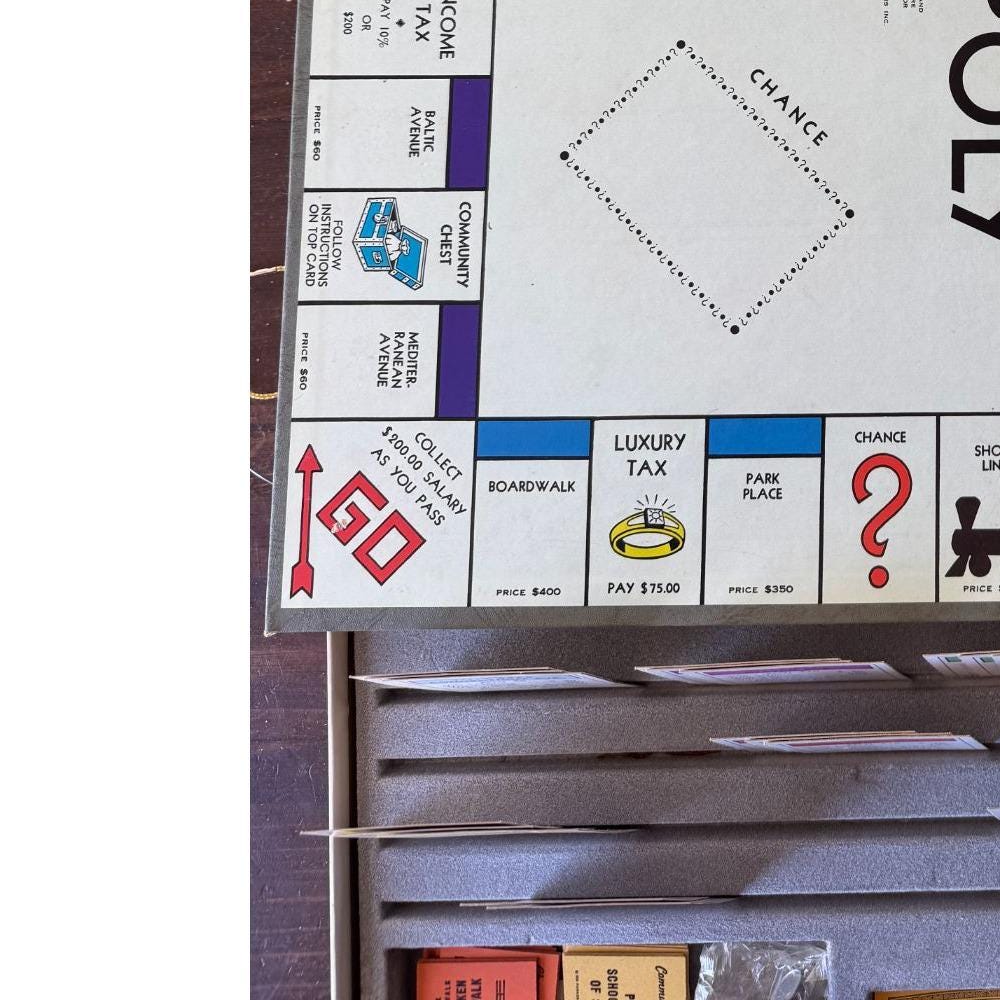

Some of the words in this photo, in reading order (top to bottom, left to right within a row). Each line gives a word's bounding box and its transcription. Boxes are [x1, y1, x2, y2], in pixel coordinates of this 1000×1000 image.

[343, 12, 353, 34] $200
[362, 15, 371, 31] OR
[380, 0, 391, 19] PAY
[416, 4, 431, 41] TAX
[377, 28, 389, 47] 10%
[750, 68, 829, 147] CHANCE
[409, 107, 421, 157] AVENUE
[423, 111, 435, 152] BALTIC
[313, 140, 321, 161] $60
[308, 204, 319, 222] ON
[307, 227, 317, 249] TOP
[318, 203, 332, 287] INSTRUCTIONS
[331, 220, 343, 271] FOLLOW
[440, 224, 452, 265] CHEST
[457, 202, 471, 288] COMMUNITY
[305, 253, 316, 287] CARD
[377, 333, 390, 387] AVENUE
[391, 332, 405, 388] RANEAN
[406, 332, 419, 388] MEDITER-
[615, 434, 686, 451] LUXURY
[855, 431, 906, 443] CHANCE
[414, 432, 463, 480] COLLECT
[627, 460, 666, 476] TAX
[381, 427, 422, 471] $200.00
[423, 472, 467, 515] SALARY
[747, 473, 779, 484] PARK
[370, 448, 390, 467] AS
[391, 468, 415, 494] YOU
[416, 495, 445, 526] PASS
[489, 481, 575, 492] BOARDWALK
[743, 488, 782, 500] PLACE
[316, 470, 427, 586] GO
[532, 588, 561, 596] $400
[608, 583, 634, 593] PAY
[641, 582, 680, 594] $75.00
[590, 980, 601, 994] OF
